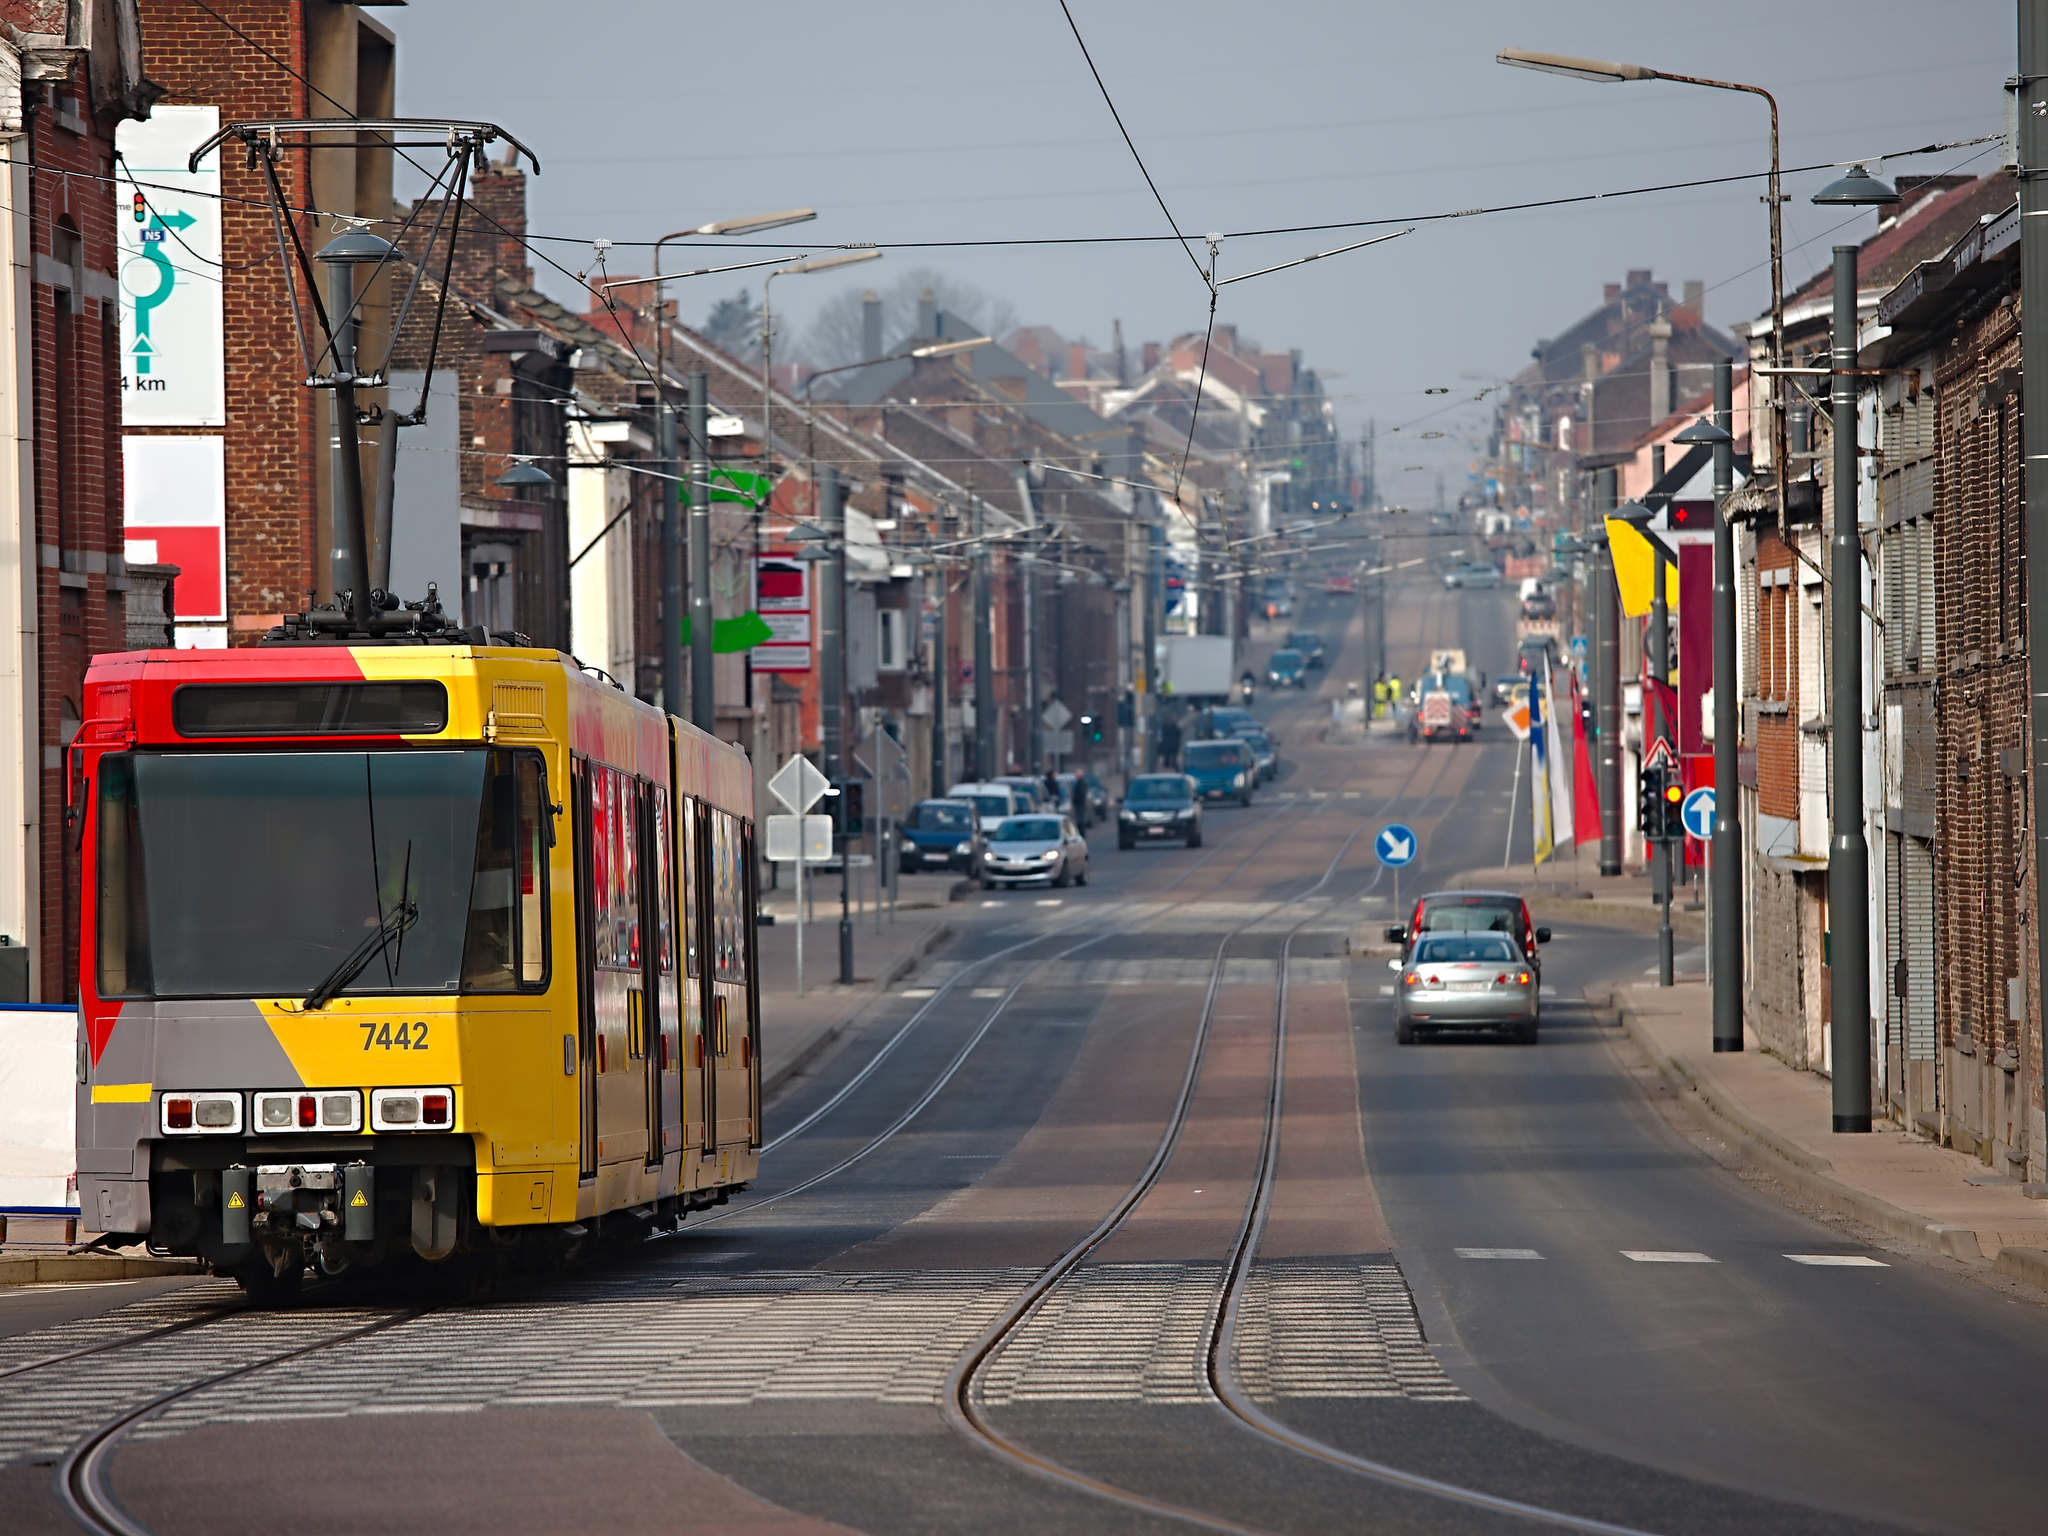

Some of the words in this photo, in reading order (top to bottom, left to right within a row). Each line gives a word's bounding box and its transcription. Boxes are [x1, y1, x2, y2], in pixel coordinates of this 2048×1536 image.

[145, 231, 161, 241] N5
[136, 375, 166, 391] km
[360, 1022, 429, 1050] 7442
